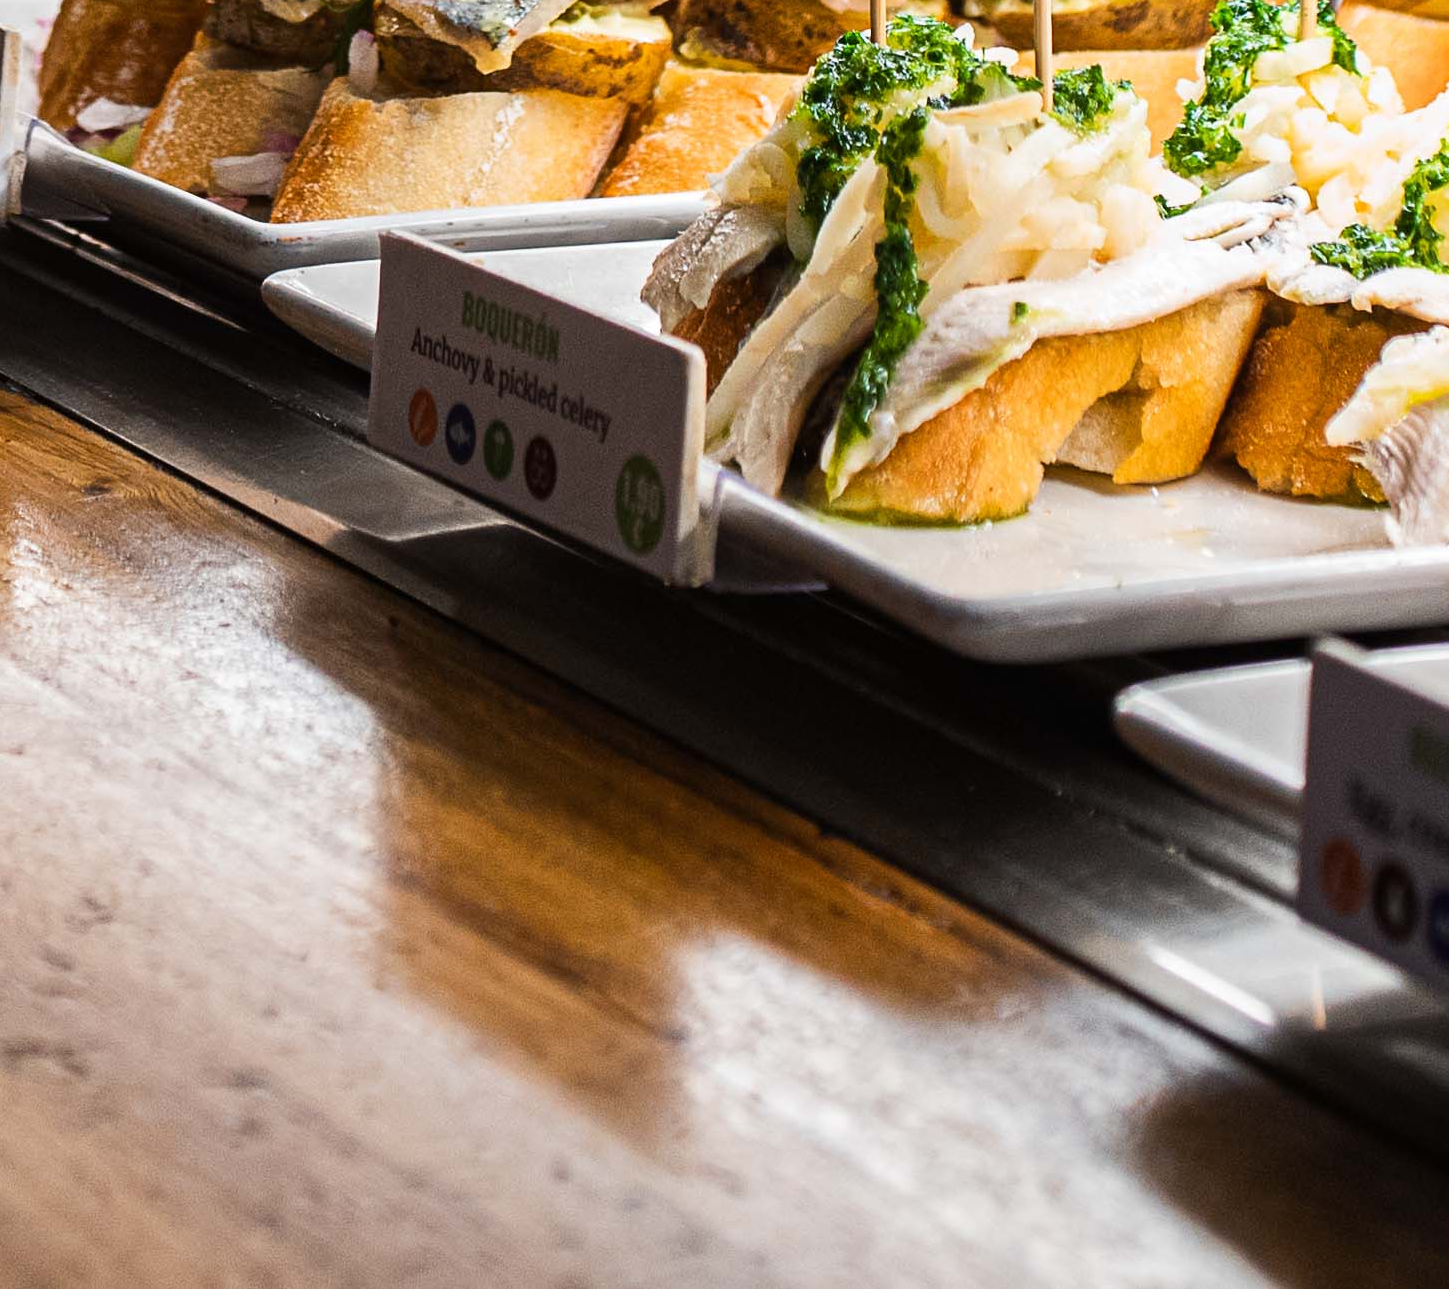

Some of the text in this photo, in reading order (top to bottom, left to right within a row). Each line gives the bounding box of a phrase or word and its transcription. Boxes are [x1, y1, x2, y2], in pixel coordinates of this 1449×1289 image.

[460, 289, 561, 364] BOQUERÓN
[410, 326, 613, 445] Anchovy & pickled celery
